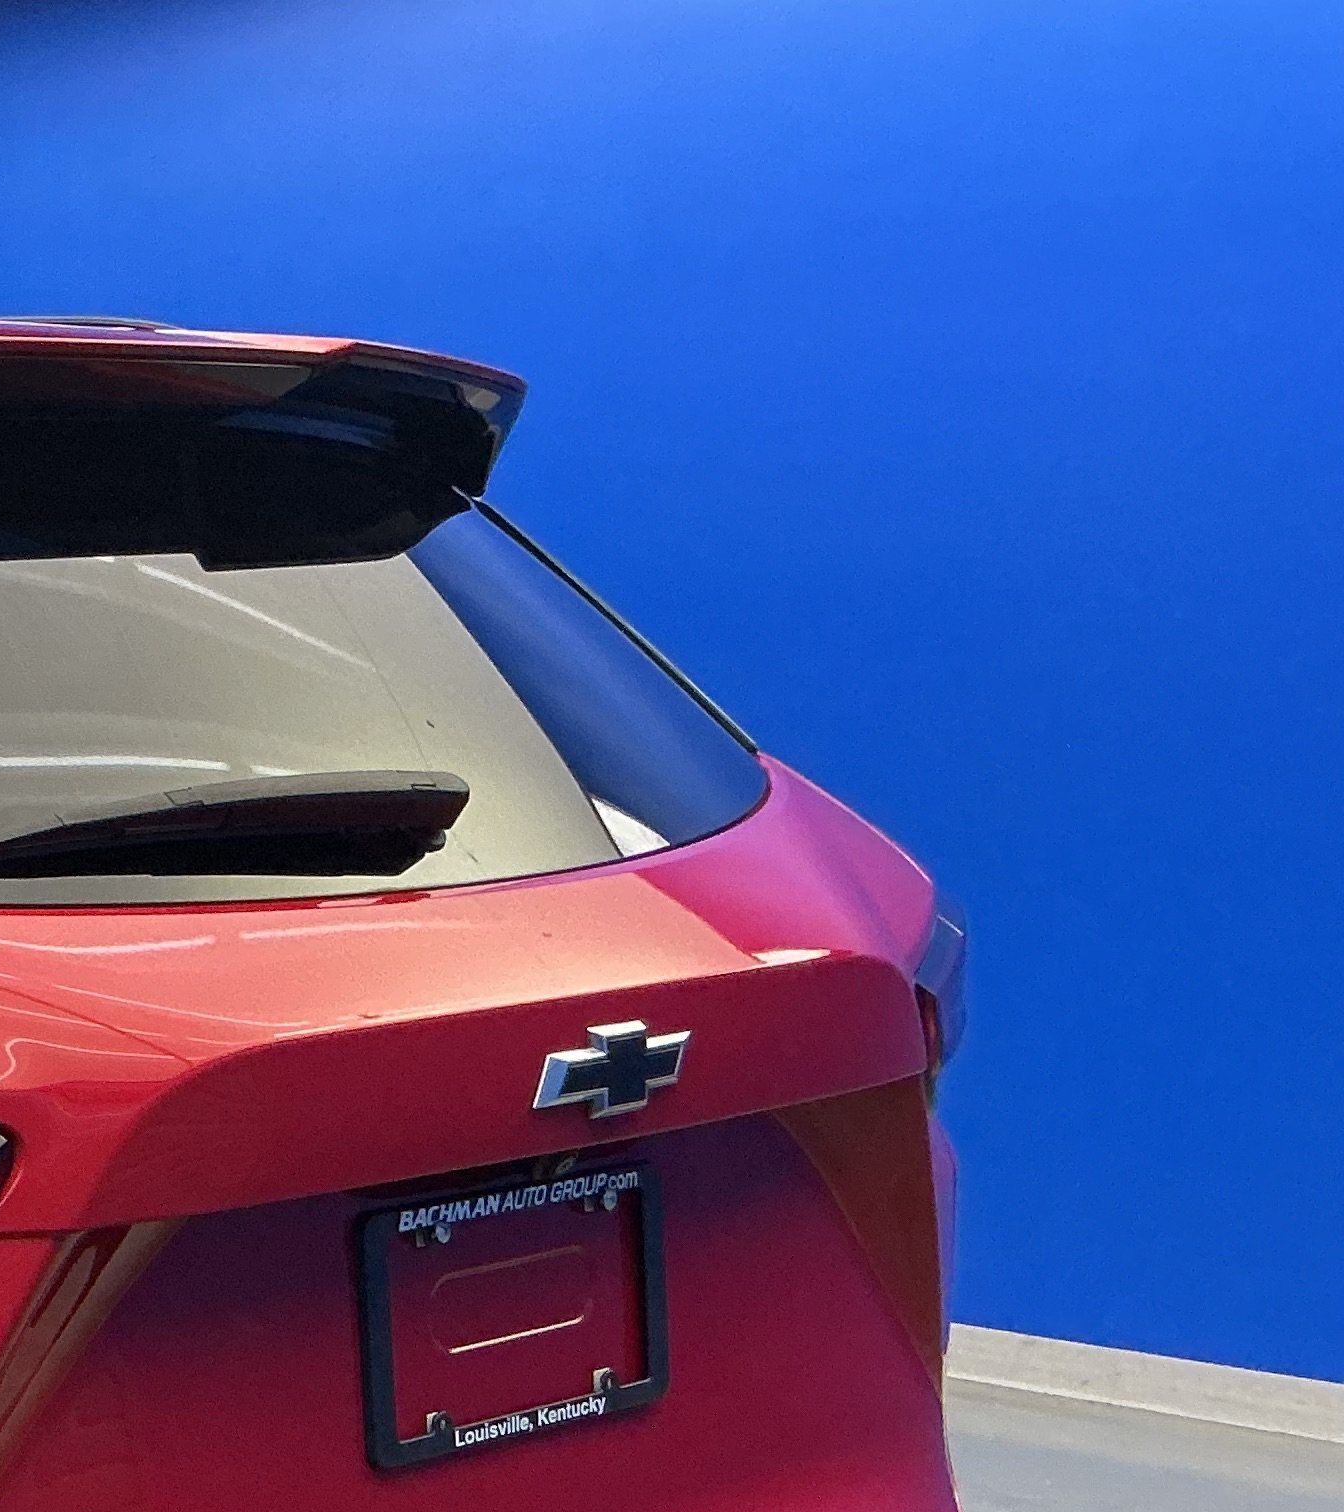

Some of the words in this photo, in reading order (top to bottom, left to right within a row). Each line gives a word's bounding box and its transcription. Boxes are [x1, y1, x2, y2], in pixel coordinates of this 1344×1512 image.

[398, 1194, 500, 1233] BACHMAN
[501, 1184, 547, 1213] AUTO
[454, 1415, 534, 1448] Louisville,
[537, 1396, 607, 1427] Kentucky
